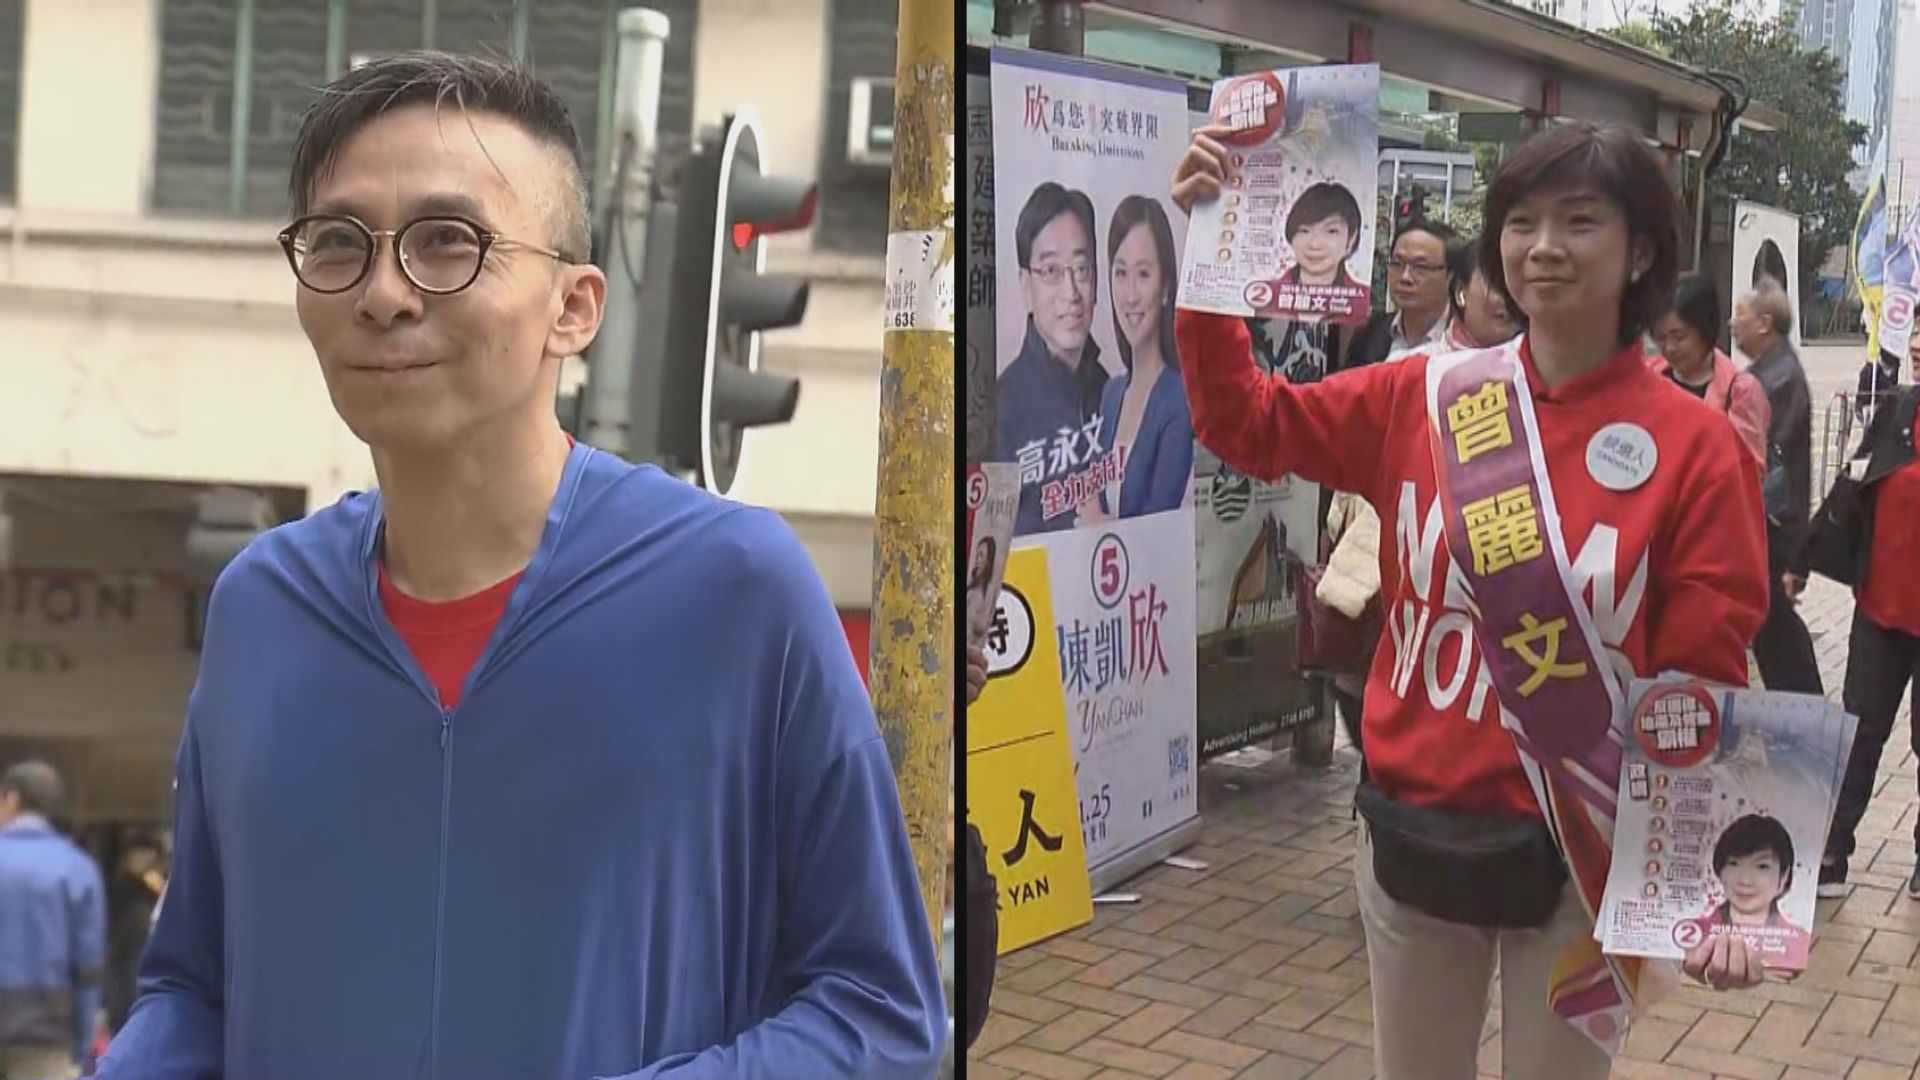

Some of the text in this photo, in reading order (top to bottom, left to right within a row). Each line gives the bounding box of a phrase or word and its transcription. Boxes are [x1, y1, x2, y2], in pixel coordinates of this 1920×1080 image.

[1250, 286, 1267, 302] 2
[1016, 413, 1104, 484] 高永文
[969, 477, 982, 504] 5
[1100, 545, 1121, 598] 5
[1002, 788, 1064, 868] 人
[1008, 874, 1050, 908] YAN
[1681, 925, 1697, 943] 2
